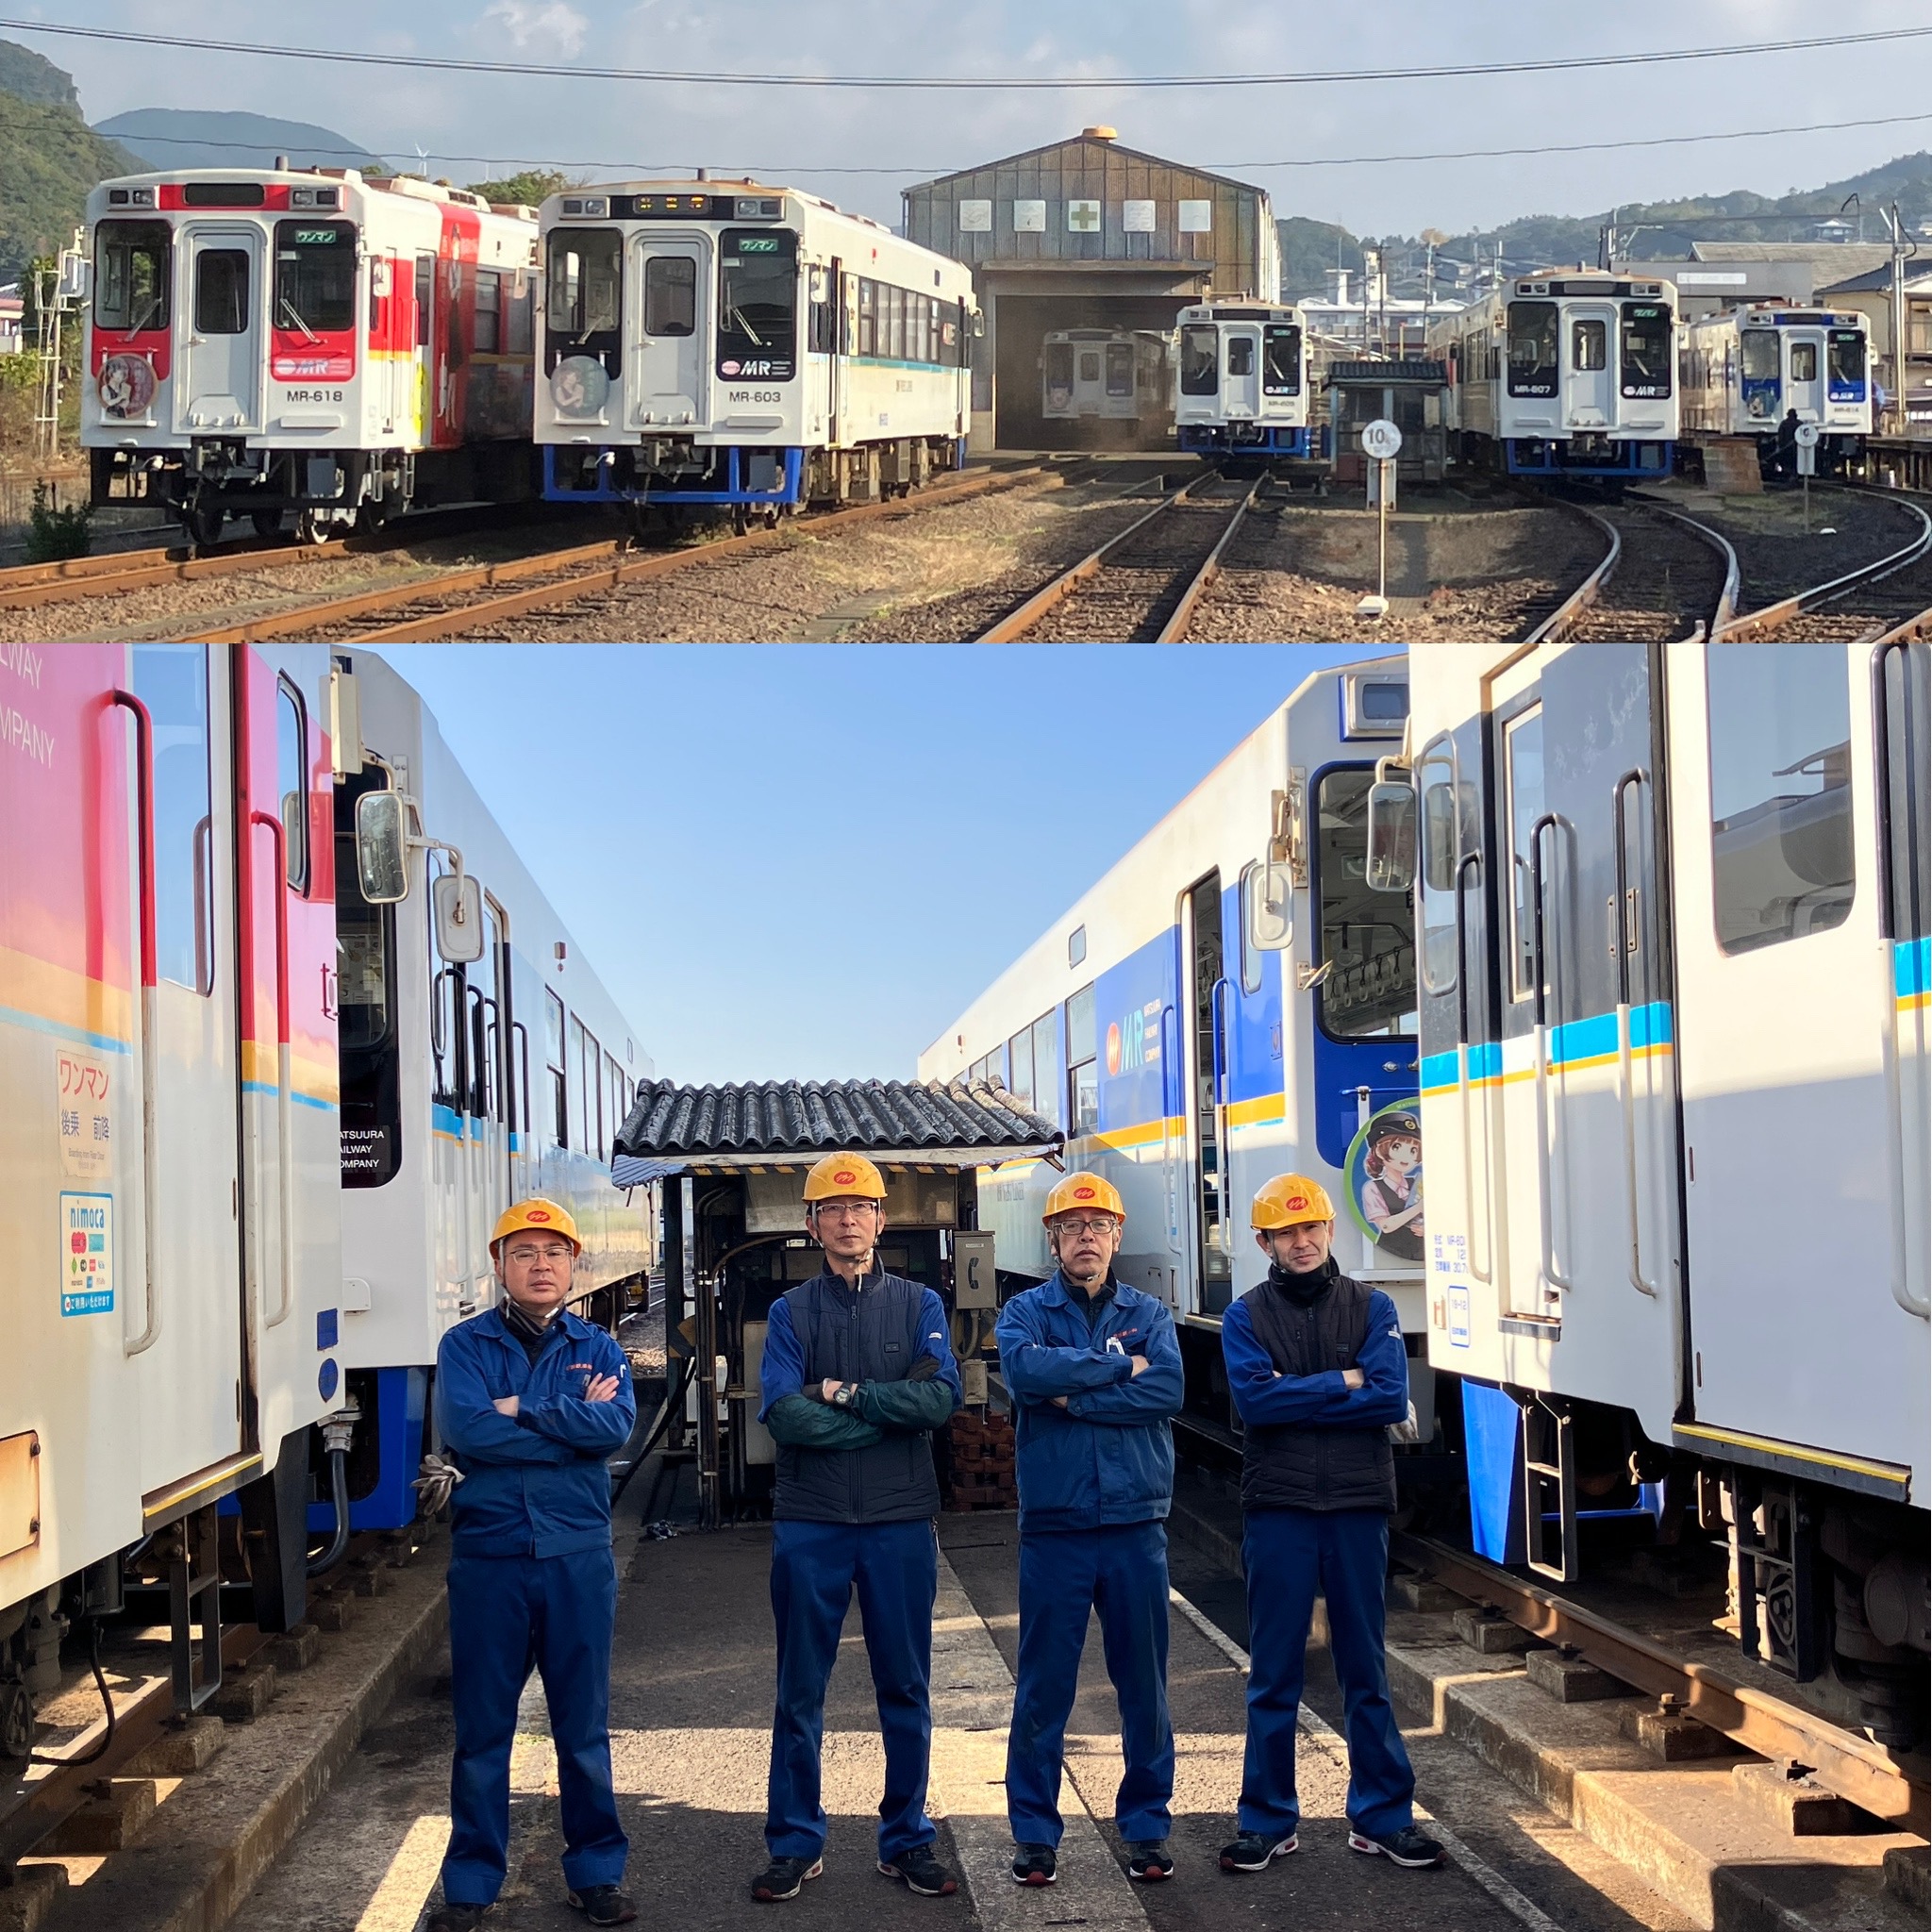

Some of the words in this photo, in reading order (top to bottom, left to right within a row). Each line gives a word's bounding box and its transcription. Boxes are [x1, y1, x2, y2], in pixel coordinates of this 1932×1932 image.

[297, 231, 334, 243] ワンマン
[741, 240, 776, 251] ワンマン
[740, 360, 772, 375] MR
[287, 391, 342, 402] MR-618
[1636, 386, 1657, 395] MR
[729, 391, 781, 403] MR-603
[1367, 428, 1385, 444] 10
[59, 1058, 109, 1101] ワンマン
[70, 1199, 105, 1228] nimoca
